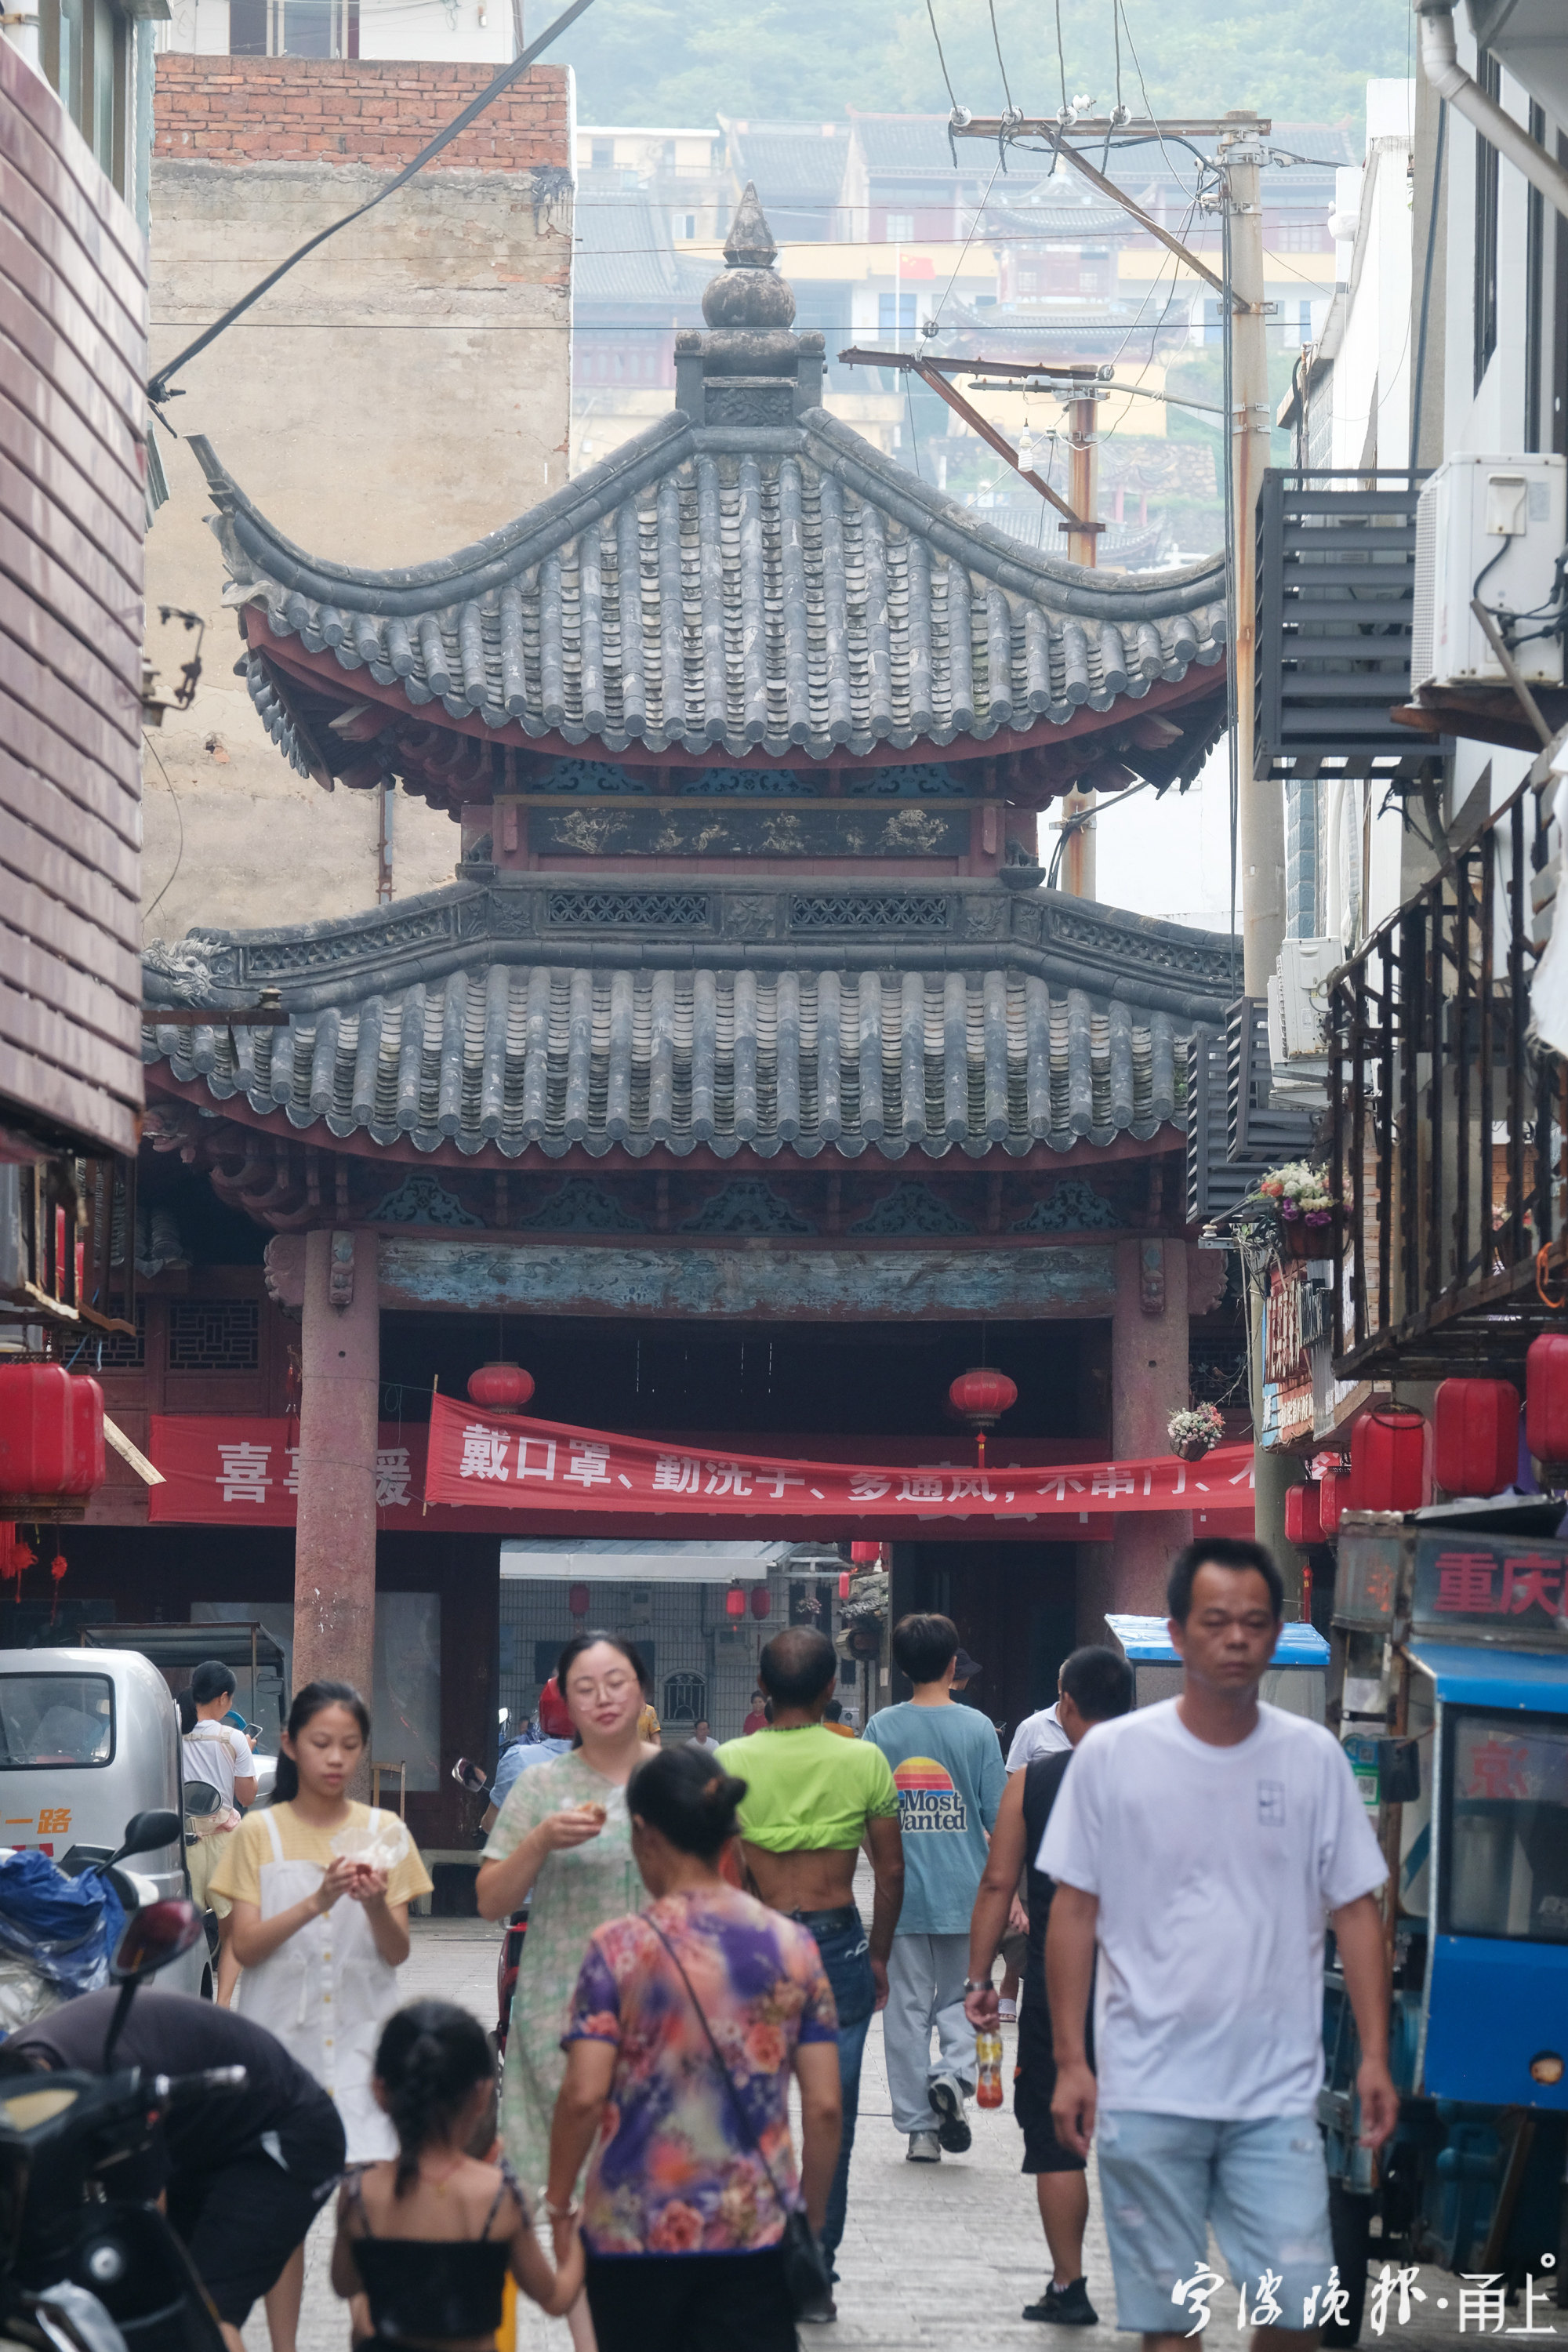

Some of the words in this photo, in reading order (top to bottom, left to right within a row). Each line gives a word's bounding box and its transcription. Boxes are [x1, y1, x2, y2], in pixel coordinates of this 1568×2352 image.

[1433, 1552, 1568, 1616] 重庆
[904, 1790, 960, 1811] Most
[0, 1808, 72, 1834] 一路
